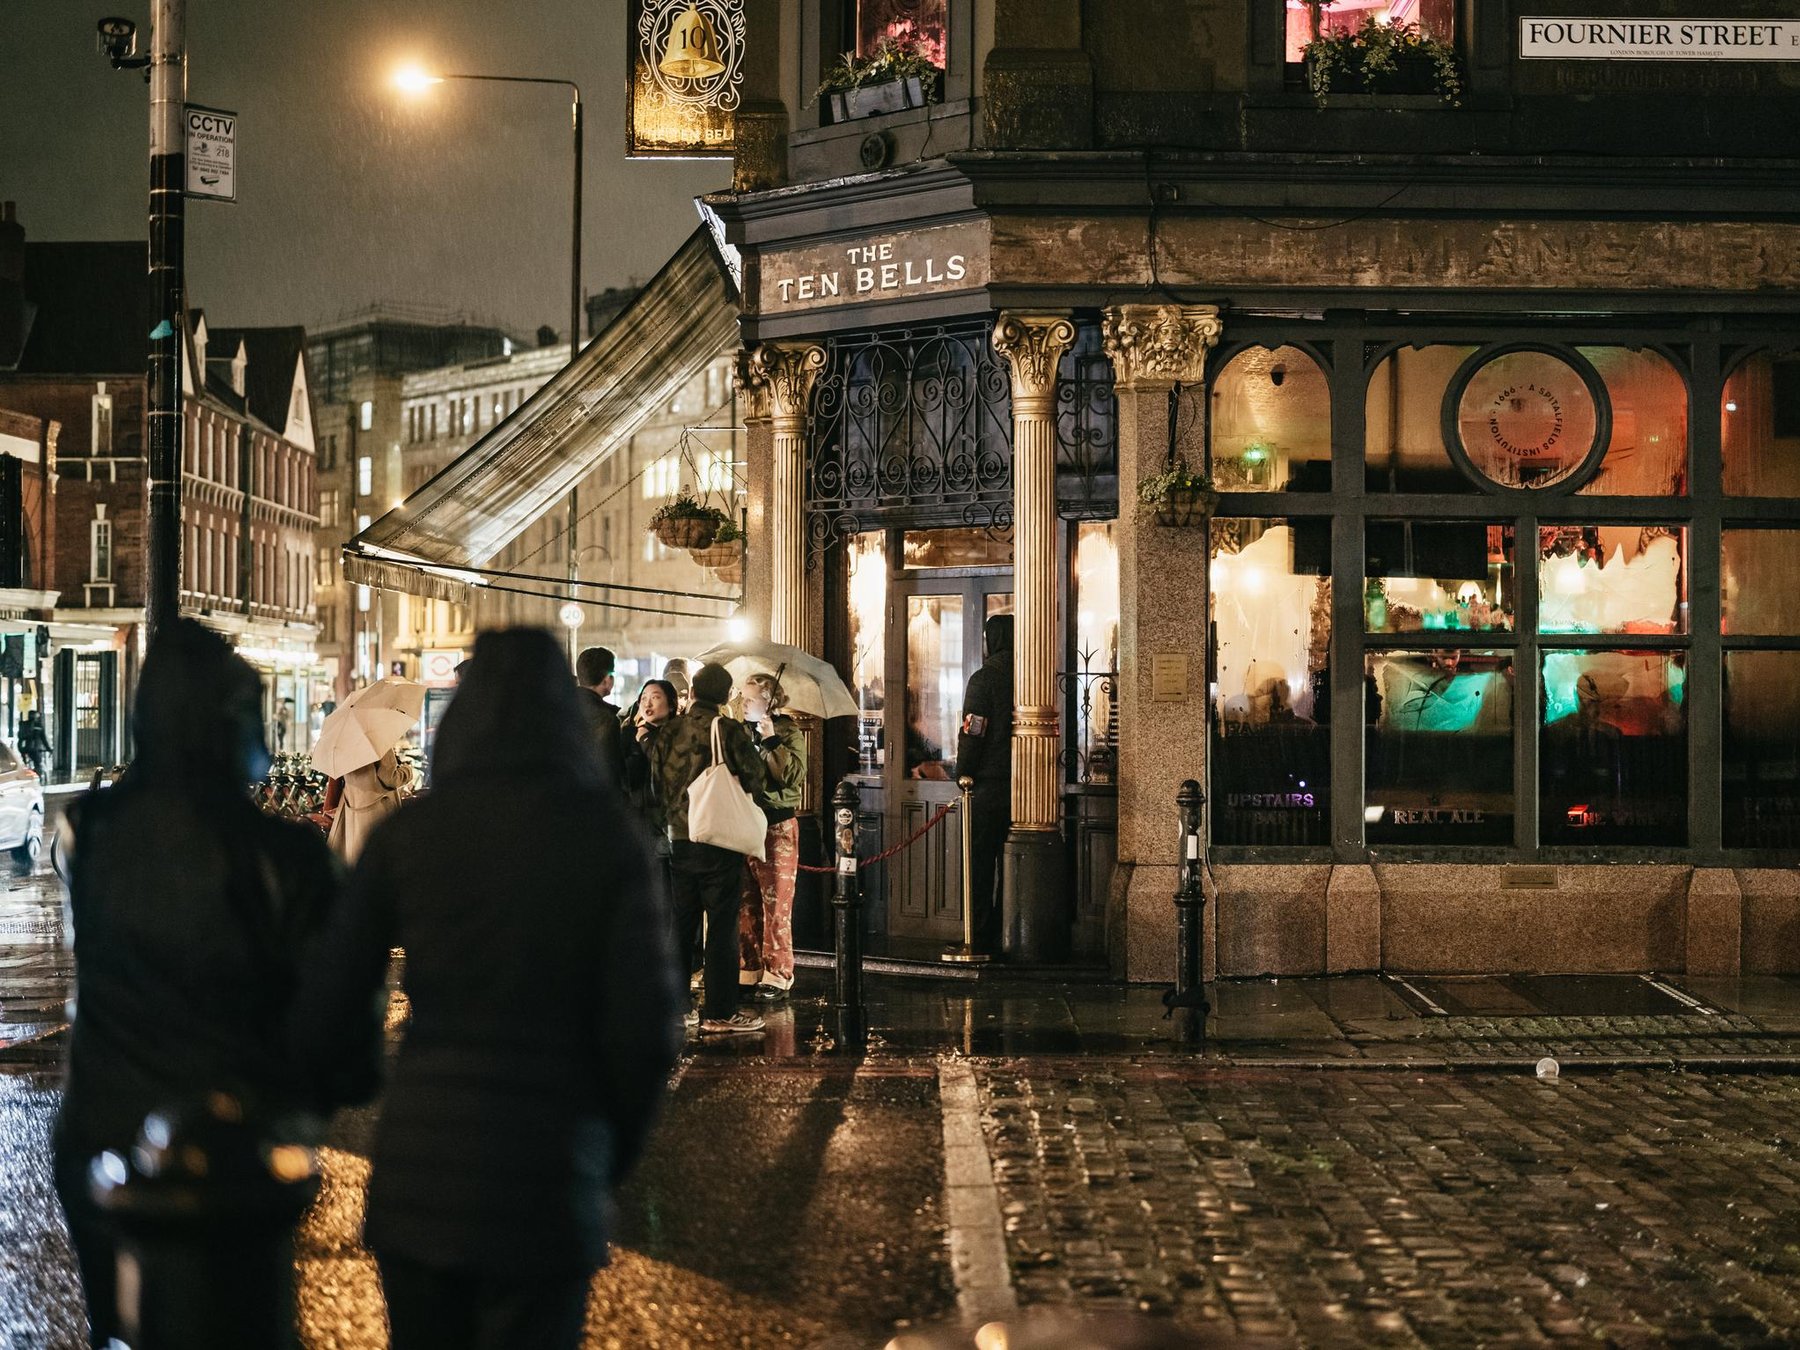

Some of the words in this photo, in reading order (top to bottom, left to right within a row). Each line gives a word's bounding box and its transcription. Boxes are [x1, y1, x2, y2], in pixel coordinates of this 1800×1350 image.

[680, 26, 706, 49] 10
[1529, 23, 1674, 45] FOURNIER
[1680, 25, 1783, 47] STREET
[190, 115, 232, 134] CCTV
[197, 133, 233, 144] OPERATION
[216, 149, 229, 158] 218
[847, 243, 893, 265] THE
[778, 272, 839, 303] TEN
[856, 255, 966, 293] BELLS
[1494, 387, 1516, 406] 1666
[1539, 387, 1563, 450] SPITALFIELDS
[1490, 418, 1540, 457] INSTITUTION
[1227, 792, 1315, 808] UPSTAIRS
[1394, 809, 1443, 825] REAL
[1449, 809, 1485, 824] ALE
